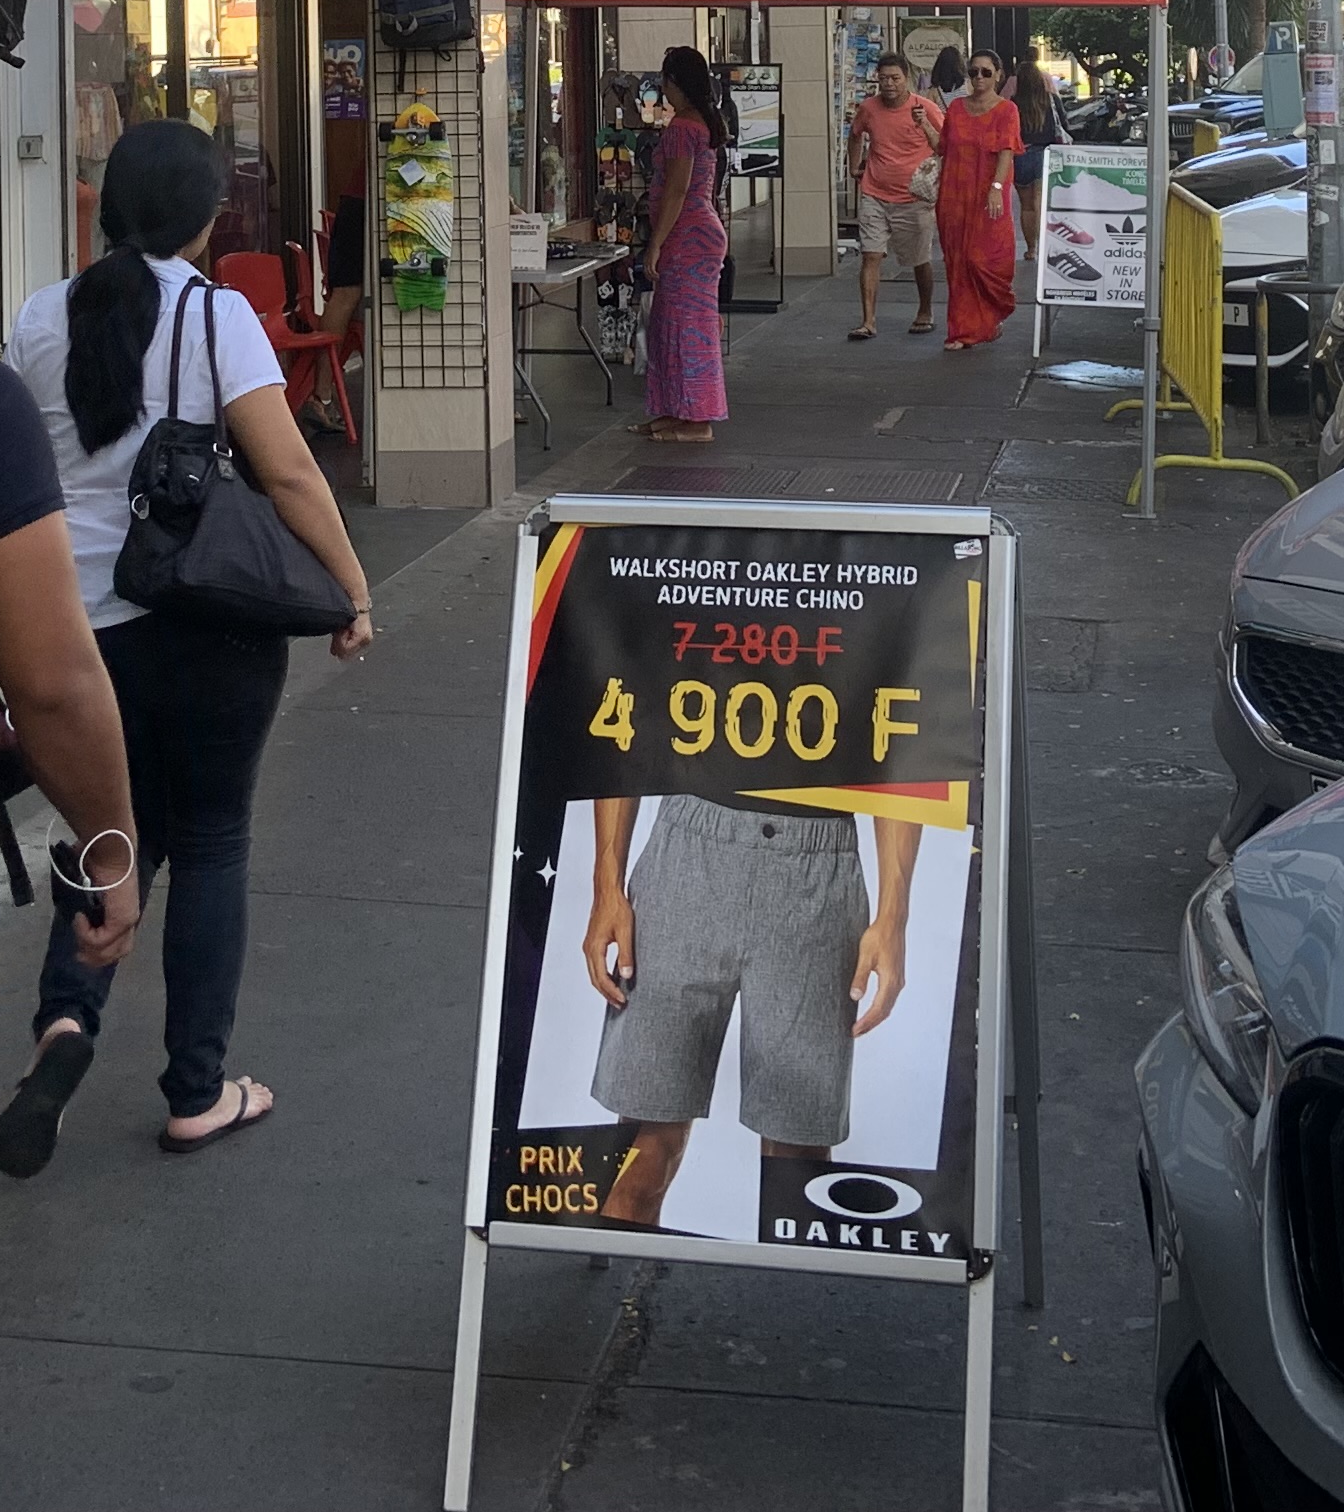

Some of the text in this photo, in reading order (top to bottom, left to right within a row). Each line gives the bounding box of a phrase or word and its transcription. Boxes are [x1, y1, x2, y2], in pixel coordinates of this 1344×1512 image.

[1275, 26, 1291, 50] P
[1066, 154, 1086, 163] STAN
[1113, 265, 1142, 277] NEW
[1119, 277, 1133, 288] IN
[610, 557, 918, 586] WALKSHORT OAKLEY HYBRID
[657, 585, 864, 610] ADVENTURE CHINO
[673, 622, 843, 665] 7 280 F
[589, 677, 921, 763] 4 900 F
[520, 1145, 584, 1175] PRIX
[505, 1183, 599, 1213] CHOCS
[774, 1218, 952, 1253] OAKLEY
